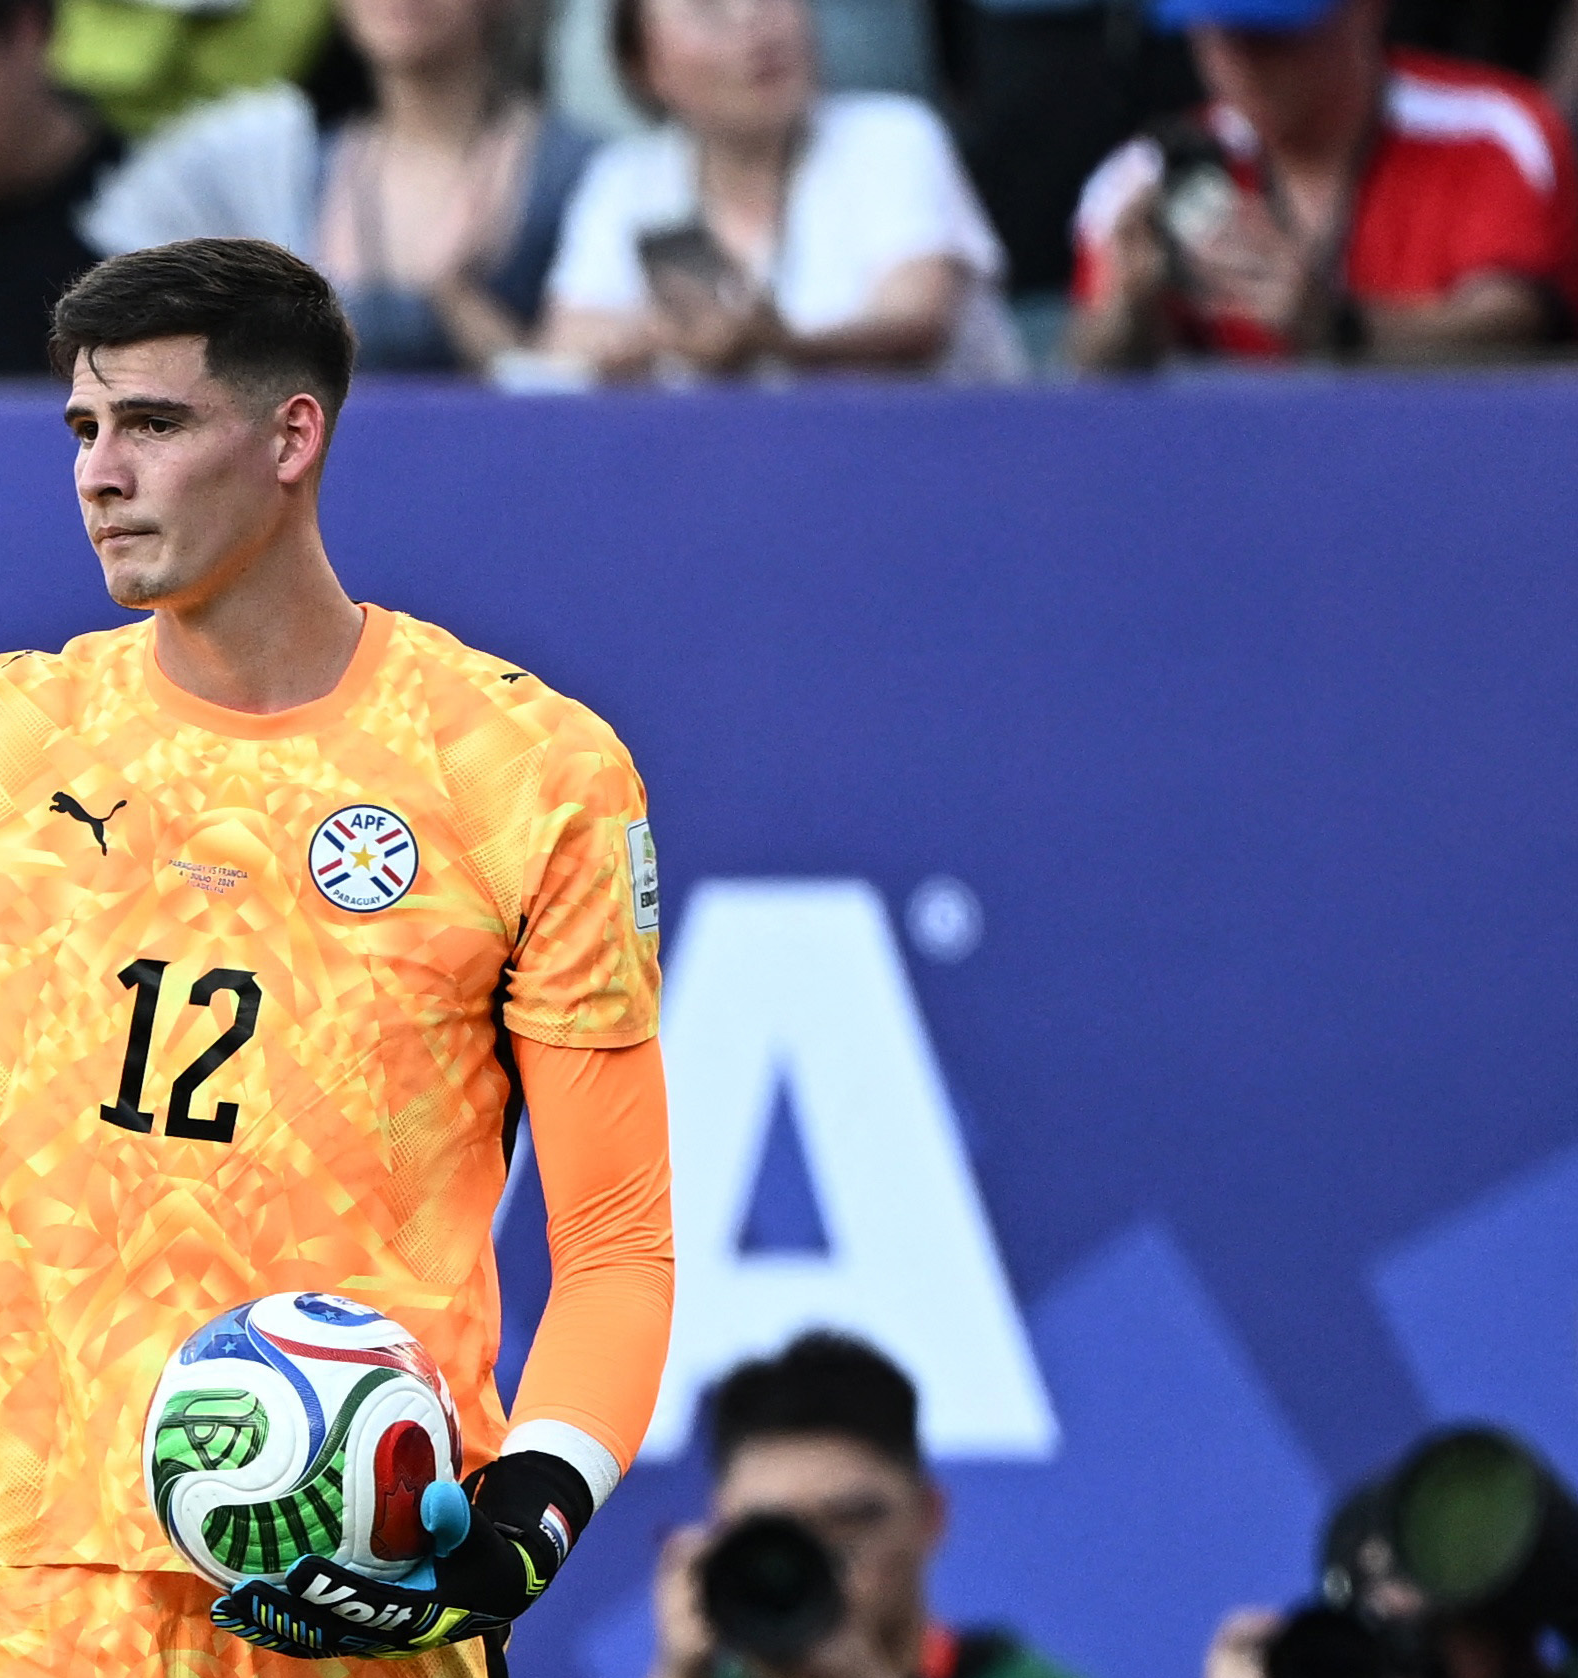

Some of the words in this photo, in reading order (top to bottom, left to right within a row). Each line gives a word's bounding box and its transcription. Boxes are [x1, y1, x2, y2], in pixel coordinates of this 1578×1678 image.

[350, 813, 387, 831] APF
[333, 889, 381, 906] PARAGUAY
[100, 958, 262, 1144] 12
[300, 1573, 413, 1631] Voit
